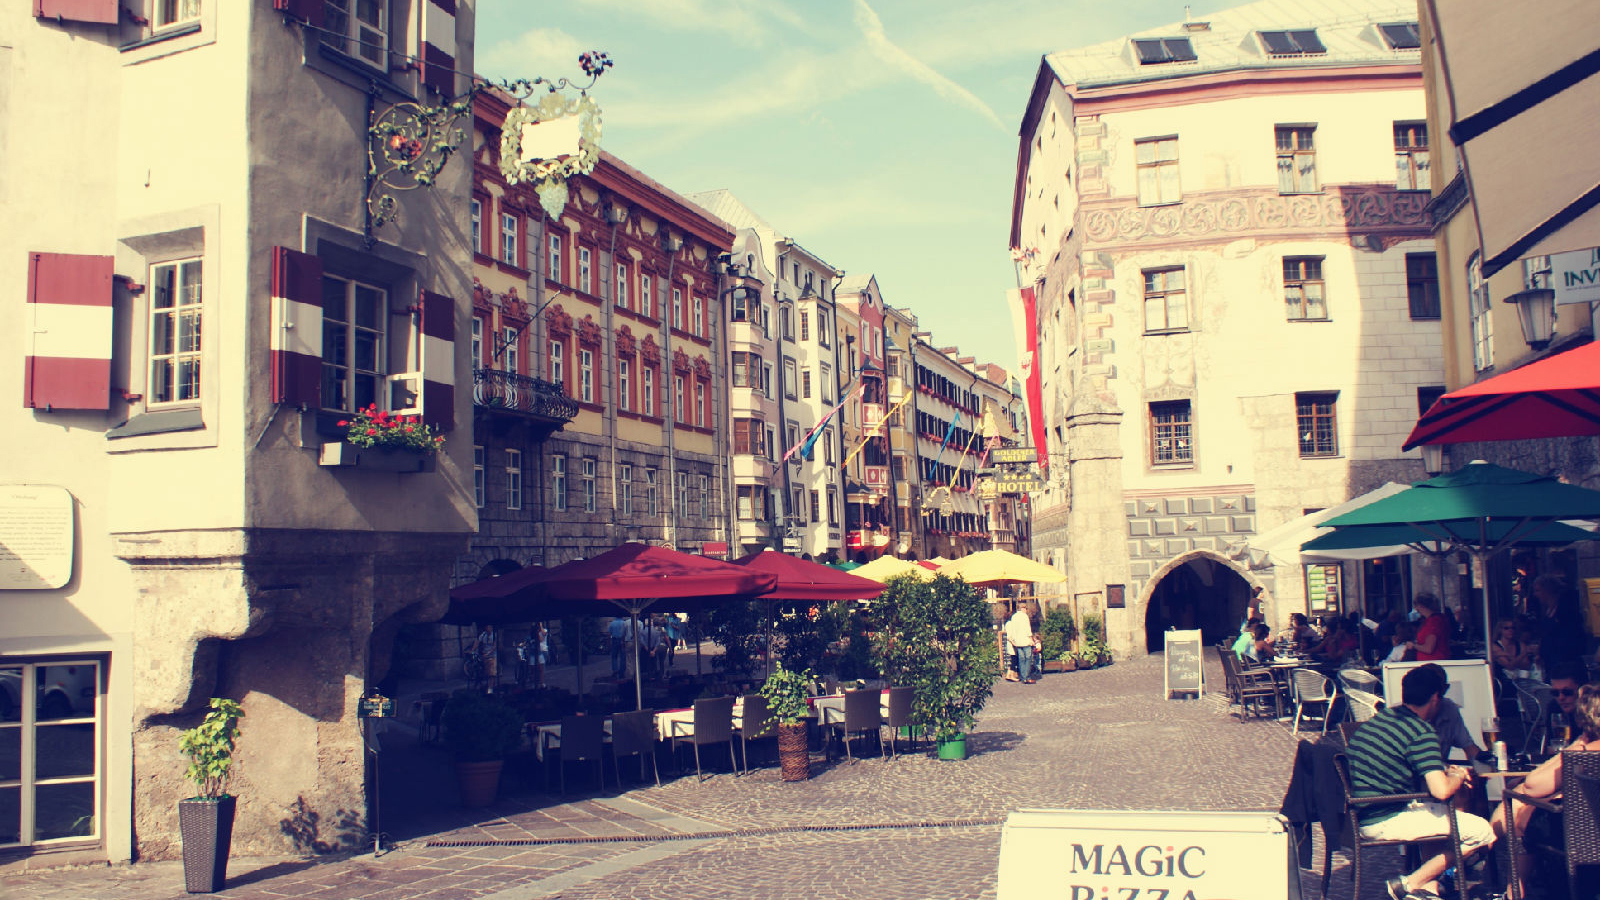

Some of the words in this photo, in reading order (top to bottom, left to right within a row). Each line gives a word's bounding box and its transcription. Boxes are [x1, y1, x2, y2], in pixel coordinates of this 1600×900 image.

[1564, 268, 1600, 286] INV
[998, 482, 1041, 492] HOTEL
[1069, 843, 1206, 878] MAGiC
